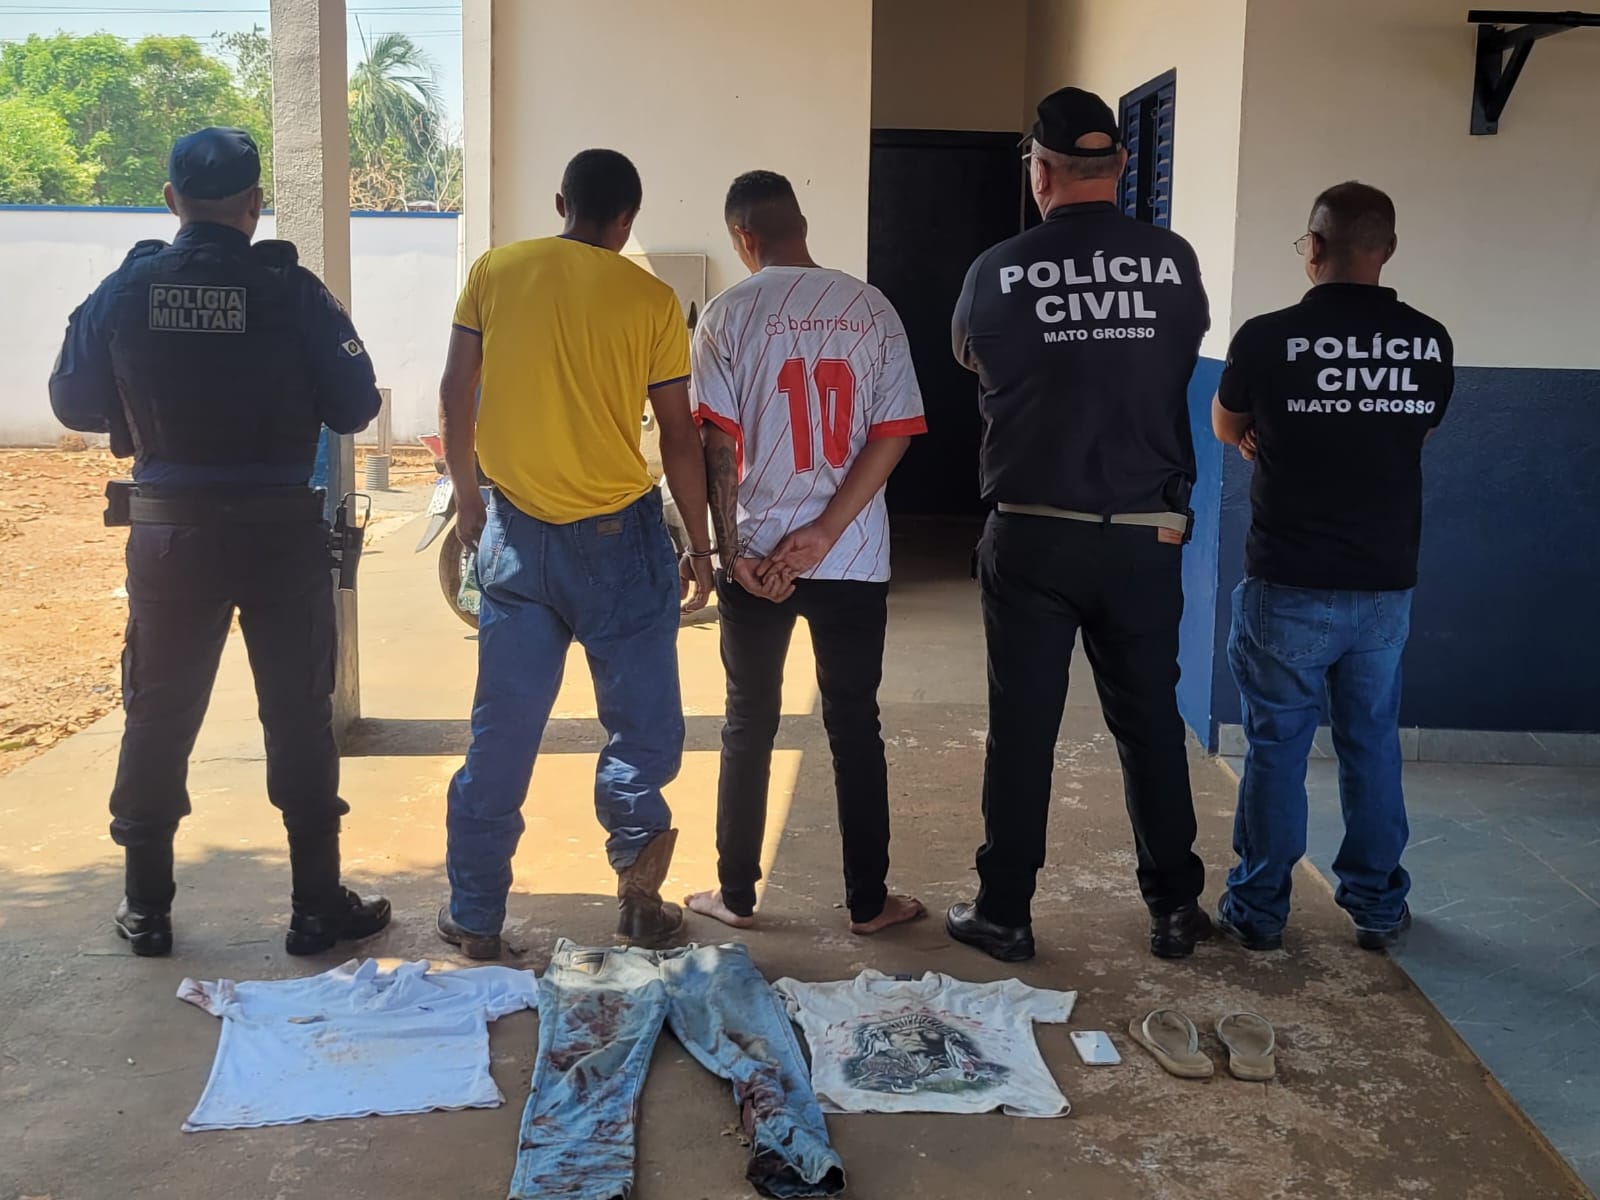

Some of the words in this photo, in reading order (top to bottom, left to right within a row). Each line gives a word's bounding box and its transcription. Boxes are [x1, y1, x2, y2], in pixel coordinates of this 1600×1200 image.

[999, 250, 1182, 295] POLÍCIA
[152, 307, 243, 330] MILITAR
[1035, 291, 1157, 323] CIVIL
[787, 314, 866, 334] banrisul
[1043, 330, 1088, 343] MATO
[1092, 328, 1156, 340] GROSSO
[1286, 332, 1442, 363] POLÍCIA
[1317, 367, 1419, 392] CIVIL
[776, 358, 857, 475] 10
[1287, 399, 1352, 413] MATO
[1358, 399, 1436, 415] GROSSO
